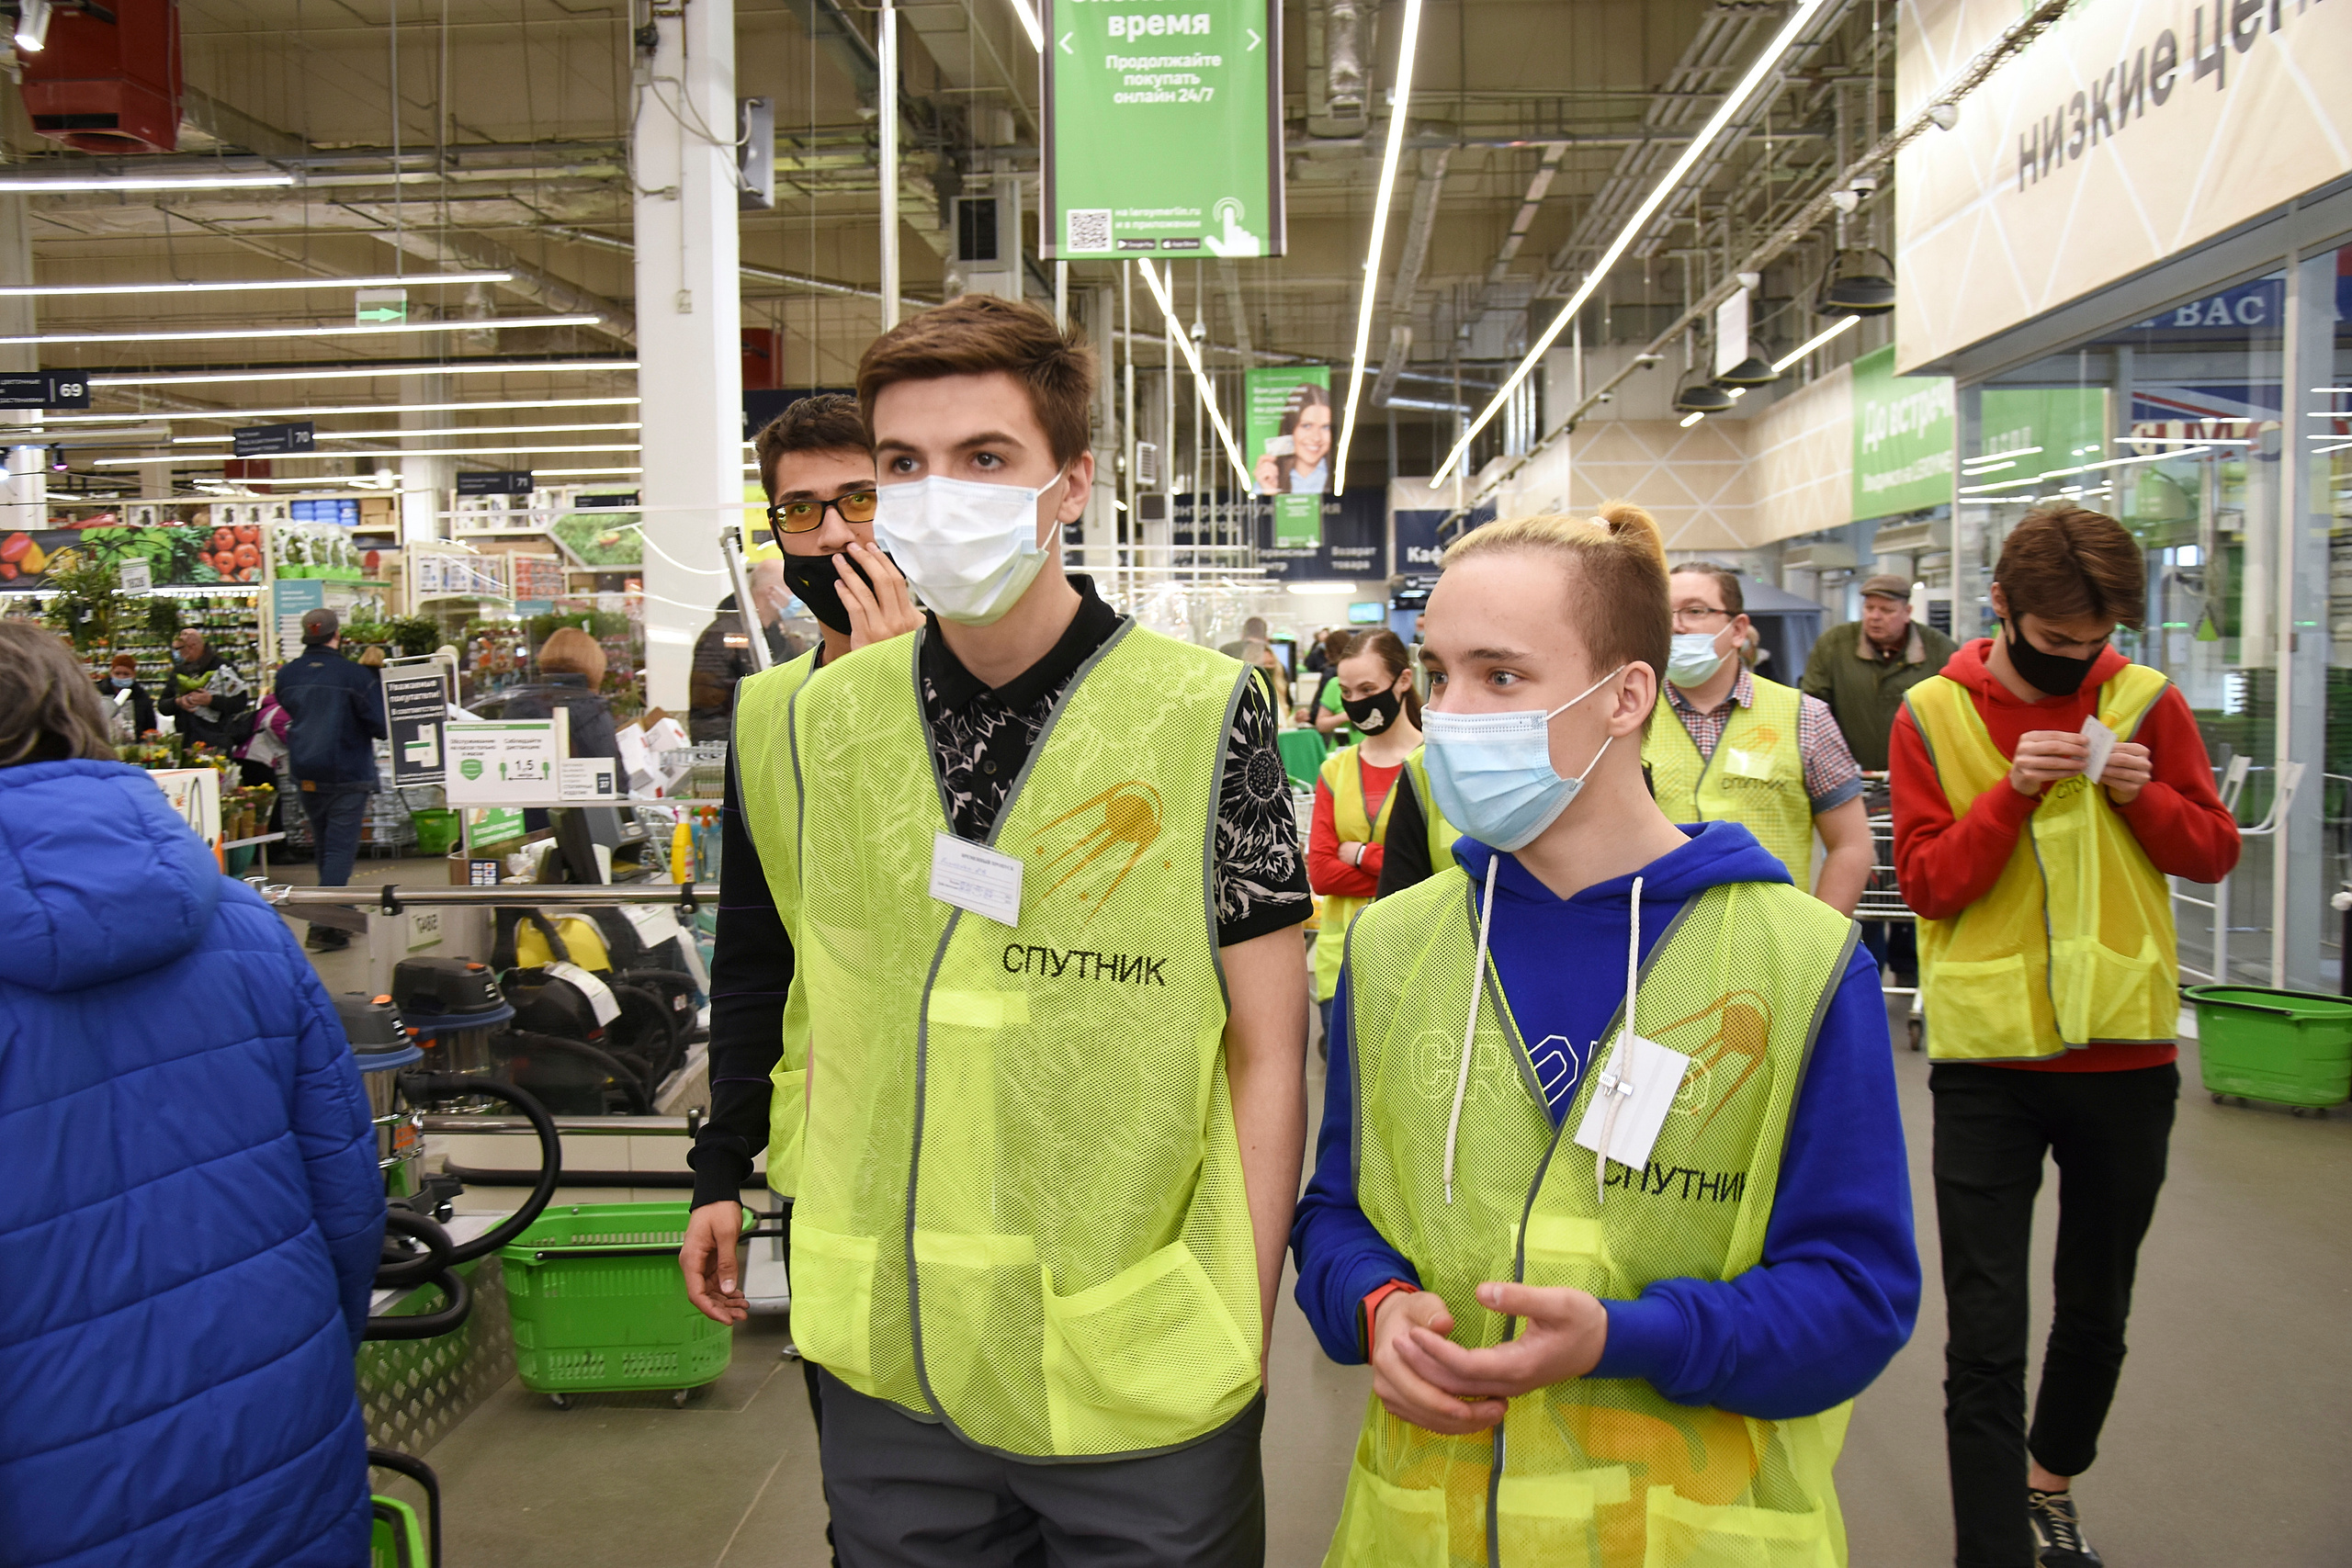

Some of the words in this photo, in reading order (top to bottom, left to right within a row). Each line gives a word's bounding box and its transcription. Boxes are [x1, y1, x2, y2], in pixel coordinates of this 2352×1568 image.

[1107, 14, 1211, 42] время
[1105, 52, 1222, 72] Продолжайте
[1124, 72, 1201, 88] покупать
[1114, 88, 1175, 104] онлайн
[1178, 87, 1215, 102] 24/7
[2018, 28, 2177, 193] низкие
[2174, 296, 2266, 326] ВАС
[60, 383, 84, 397] 69
[1862, 400, 1886, 454] До
[295, 431, 311, 443] 70
[516, 477, 528, 487] 71
[1407, 545, 1444, 567] Каф
[388, 680, 438, 691] Уважаемые
[389, 690, 442, 703] покупатели!
[514, 760, 534, 773] 1,5
[1001, 943, 1170, 987] СПУТНИК
